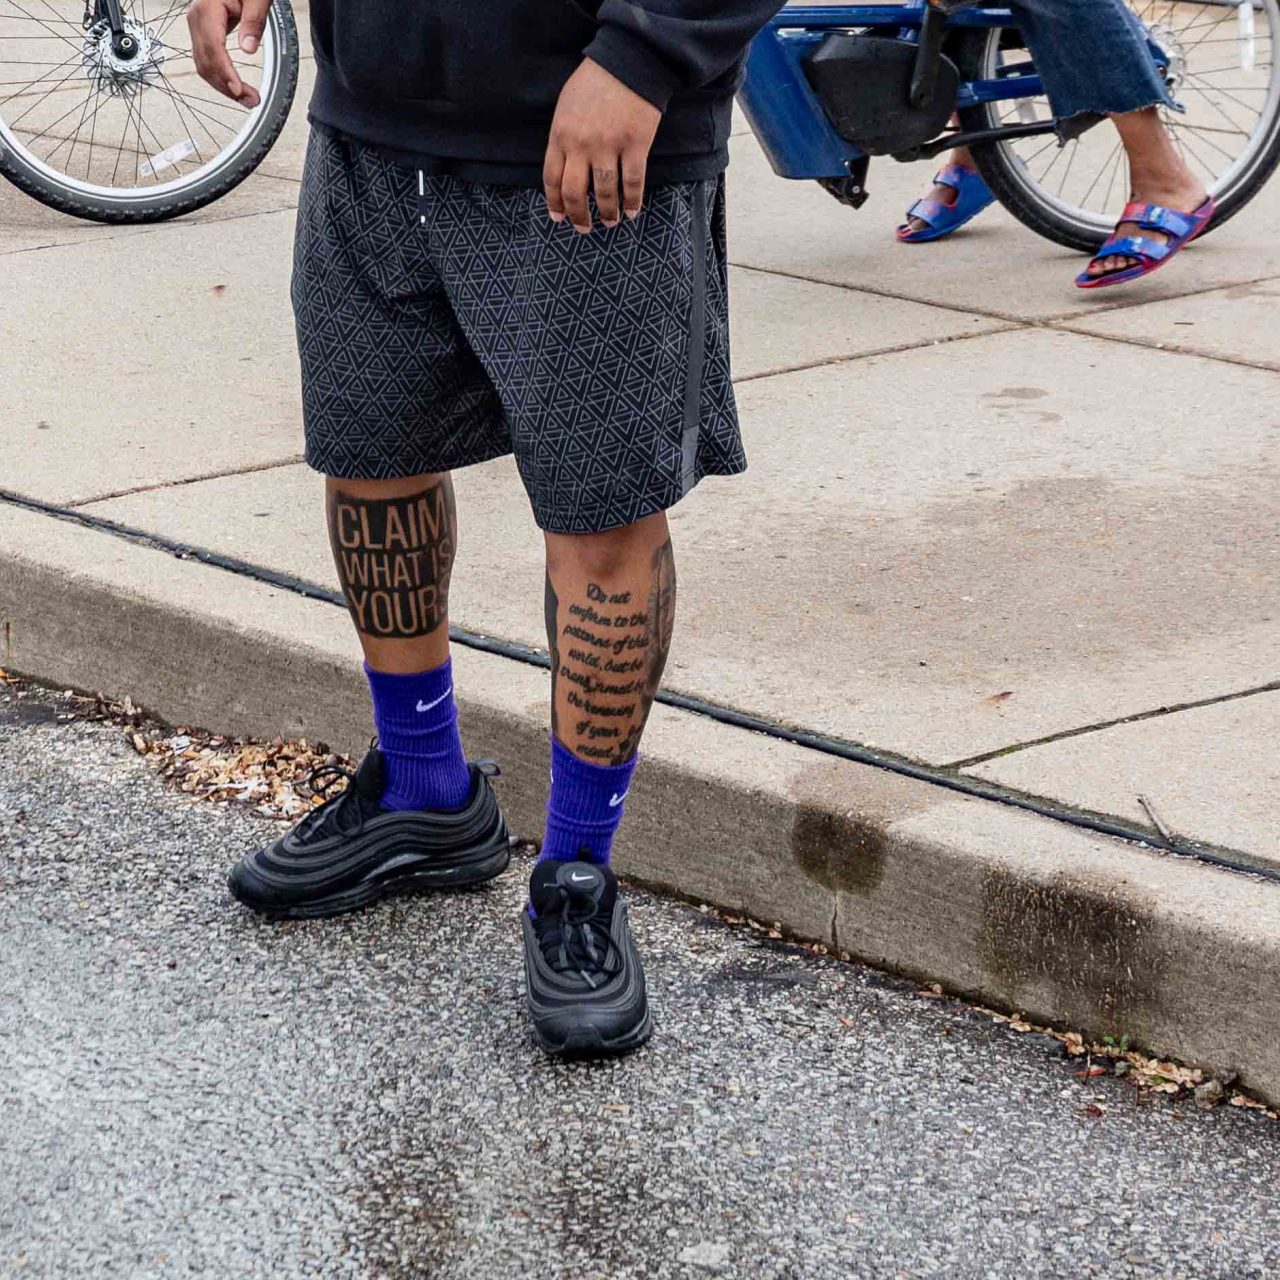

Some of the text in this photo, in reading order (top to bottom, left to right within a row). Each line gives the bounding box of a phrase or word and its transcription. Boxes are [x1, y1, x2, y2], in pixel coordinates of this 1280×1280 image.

[336, 486, 449, 550] CLAIM
[341, 550, 423, 589] WHAT
[586, 583, 631, 604] Do not
[569, 604, 611, 627] conform
[614, 615, 628, 627] to
[562, 624, 611, 649] patterns
[613, 634, 629, 655] of
[604, 659, 627, 673] but
[627, 657, 643, 671] be
[567, 691, 583, 708] the
[576, 720, 591, 736] of
[588, 726, 621, 740] your
